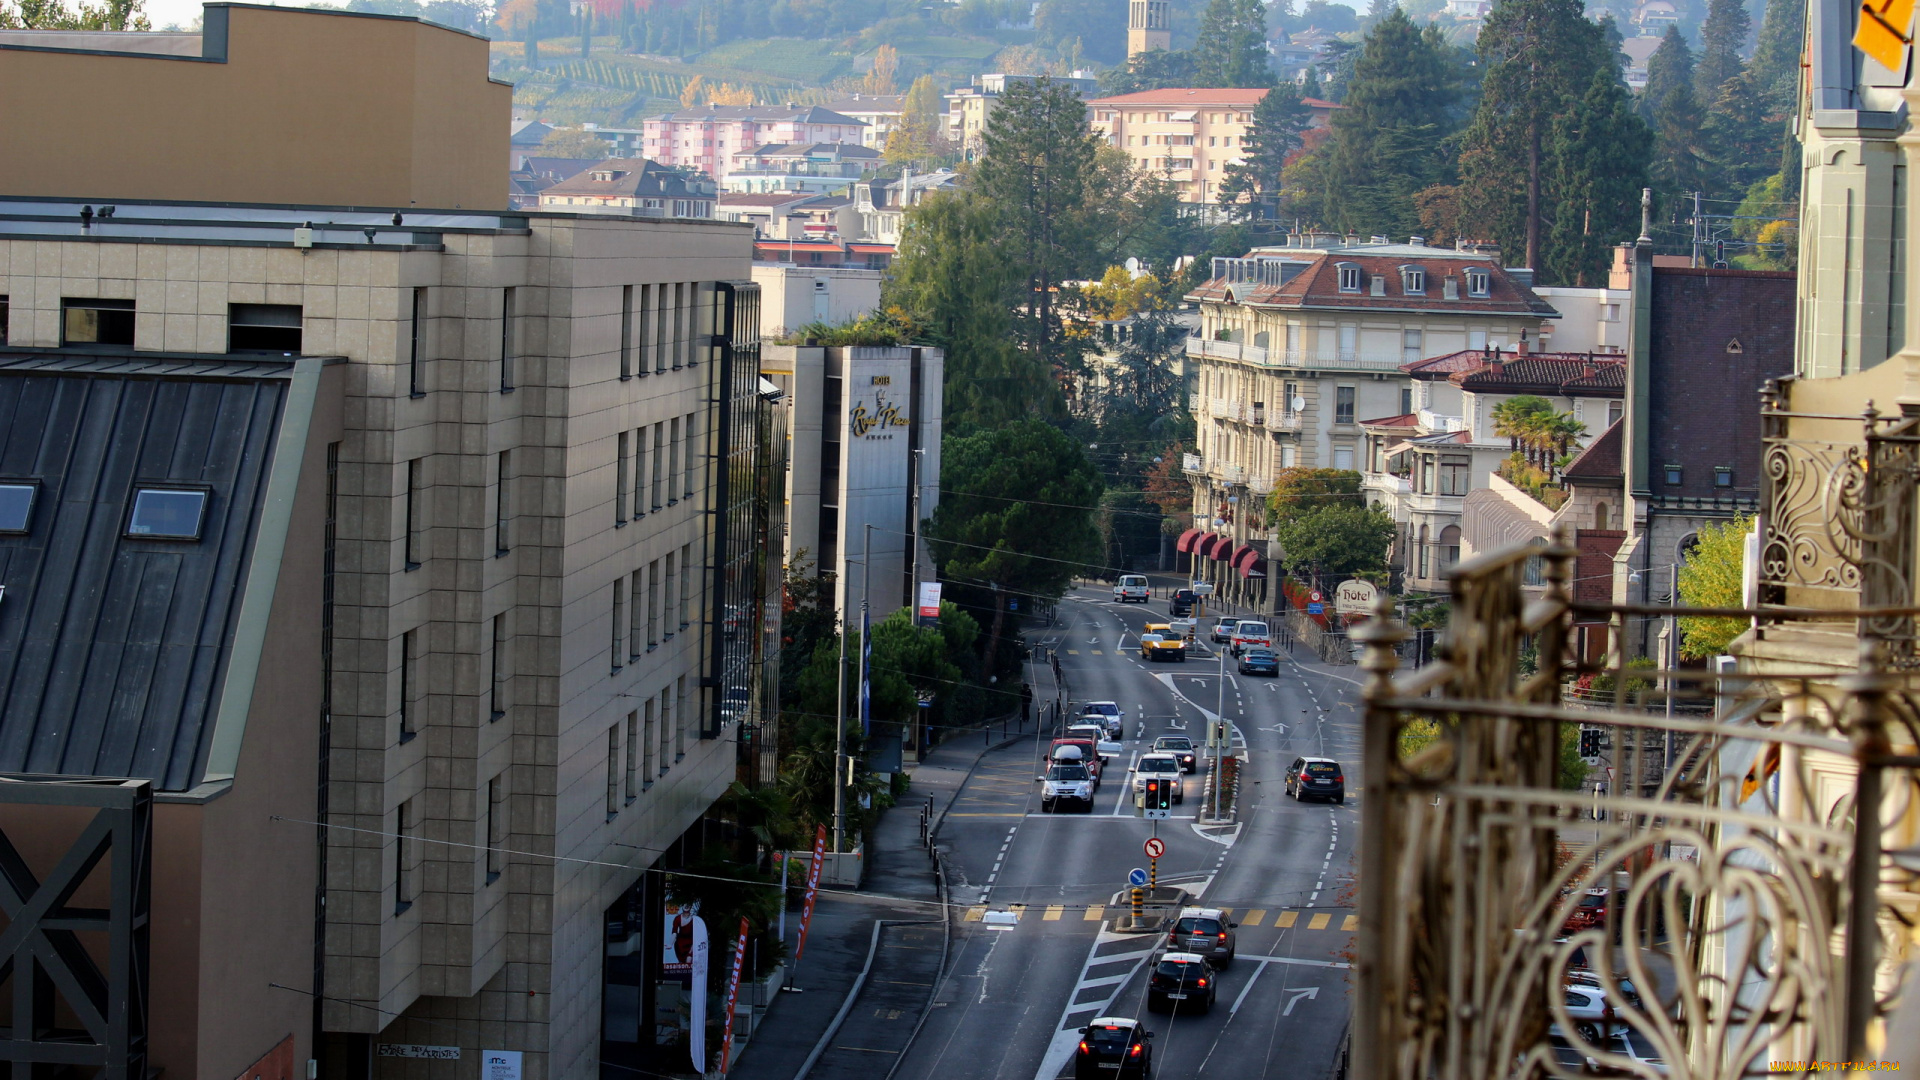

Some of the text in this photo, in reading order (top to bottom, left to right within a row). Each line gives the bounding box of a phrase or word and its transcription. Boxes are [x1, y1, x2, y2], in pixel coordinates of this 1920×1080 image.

[872, 376, 891, 385] HOTEL
[850, 401, 910, 436] Royal Plaza
[1342, 589, 1371, 602] hôtel
